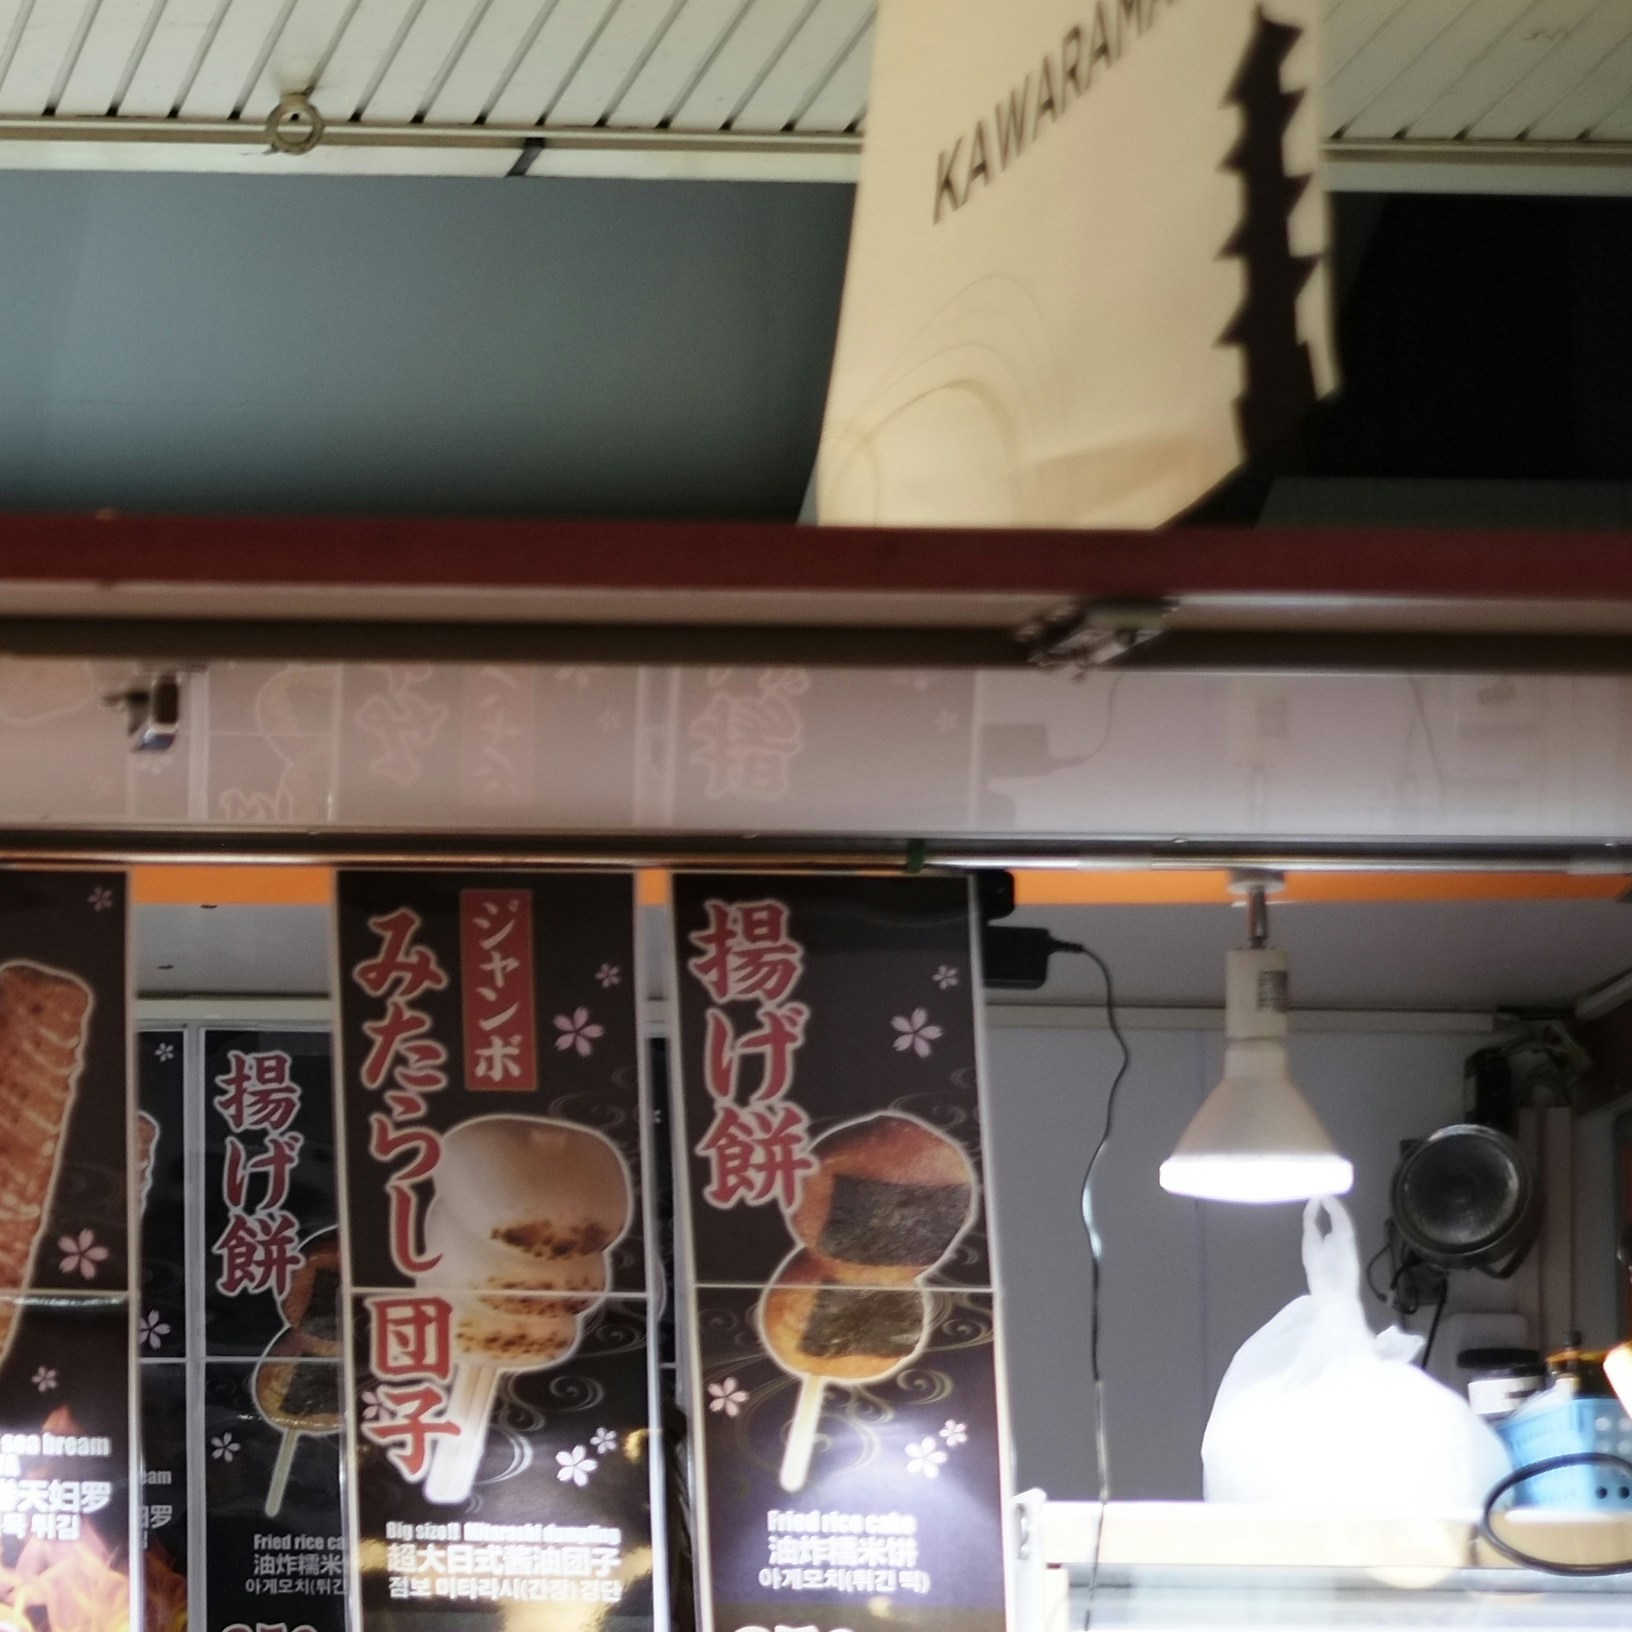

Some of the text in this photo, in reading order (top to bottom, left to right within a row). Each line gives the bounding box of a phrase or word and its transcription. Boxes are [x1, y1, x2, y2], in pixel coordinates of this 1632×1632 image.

[933, 0, 1174, 226] KAWARAM
[473, 899, 523, 1083] ジャンボ
[689, 899, 821, 1213] 揚げ餅
[212, 1050, 305, 1299] 揚げ餅
[350, 906, 463, 1485] みたらし団子
[42, 1433, 112, 1457] bream
[253, 1533, 345, 1551] Fried rice ca
[253, 1552, 344, 1577] 油炸糯米
